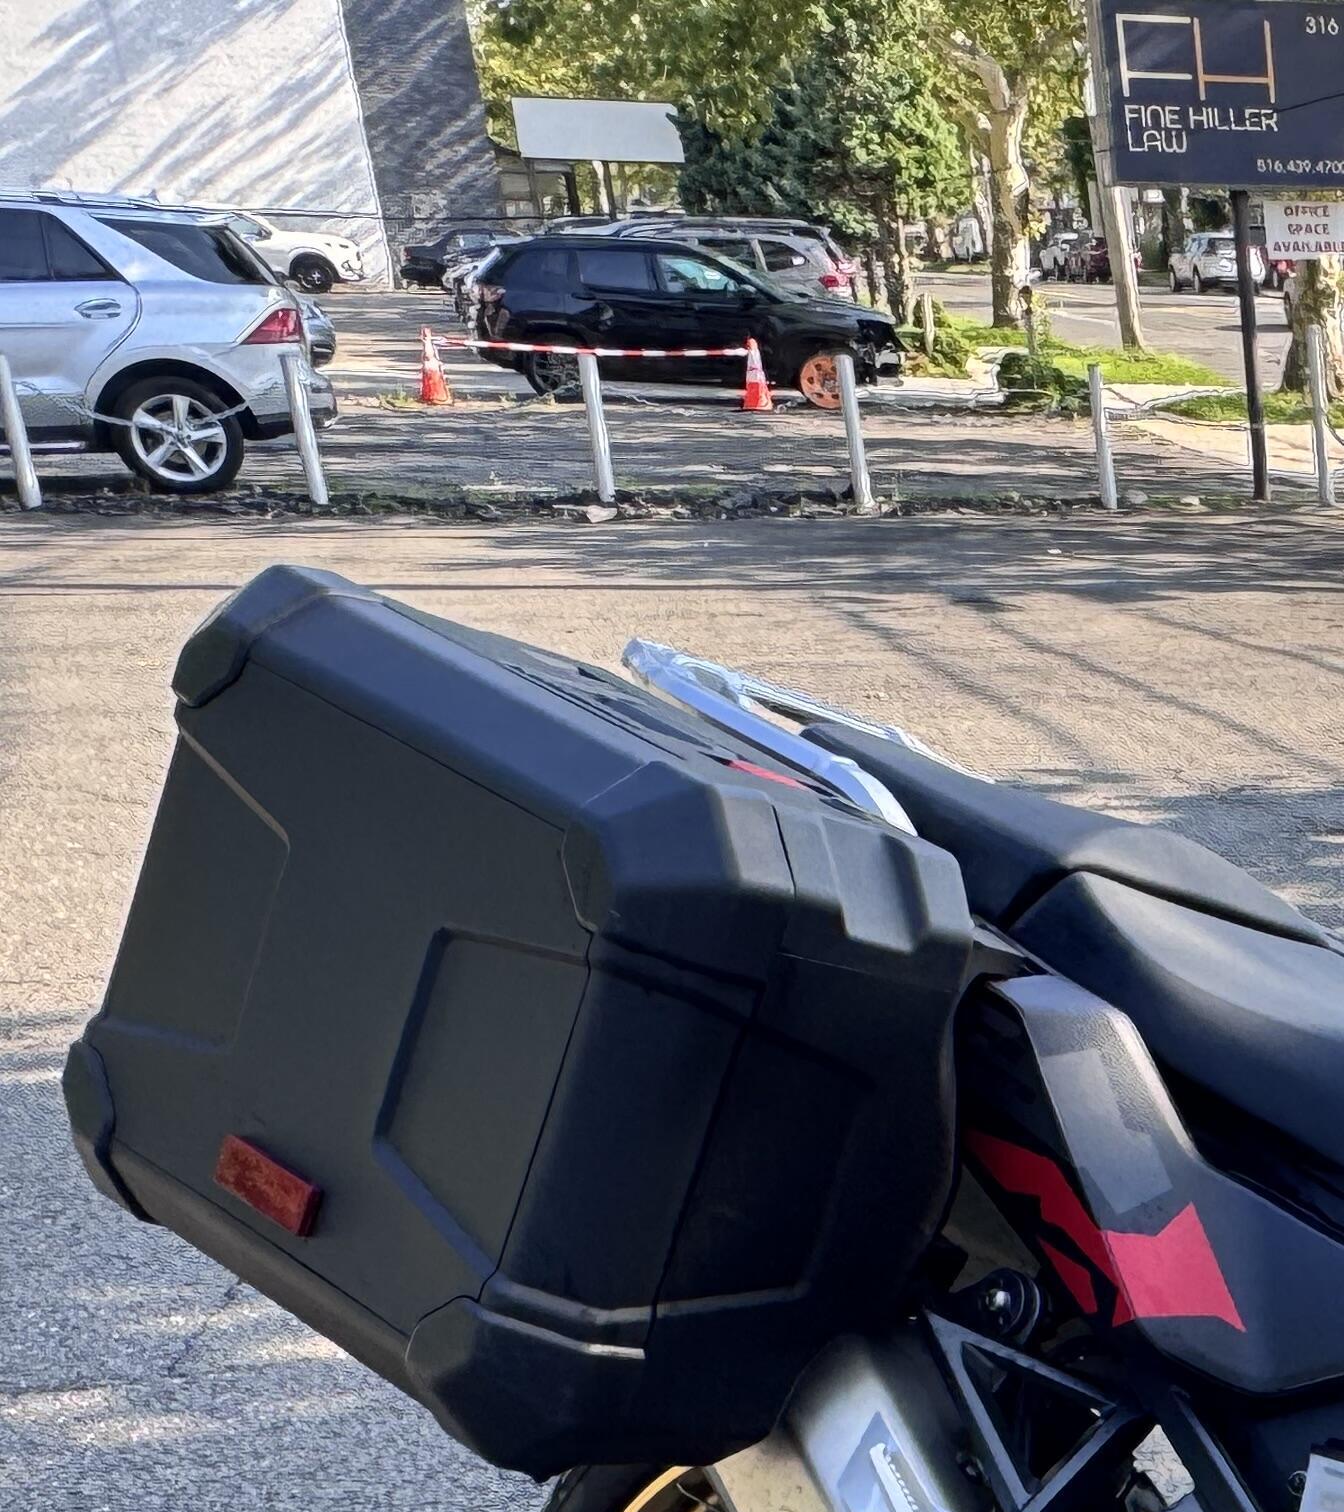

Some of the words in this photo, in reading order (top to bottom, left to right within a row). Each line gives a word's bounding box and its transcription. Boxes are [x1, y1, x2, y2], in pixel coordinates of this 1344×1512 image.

[1305, 16, 1339, 35] 316
[1124, 104, 1182, 129] FINE
[1189, 106, 1278, 132] HILLER
[1127, 130, 1188, 154] LAW
[1287, 223, 1330, 235] SPACE
